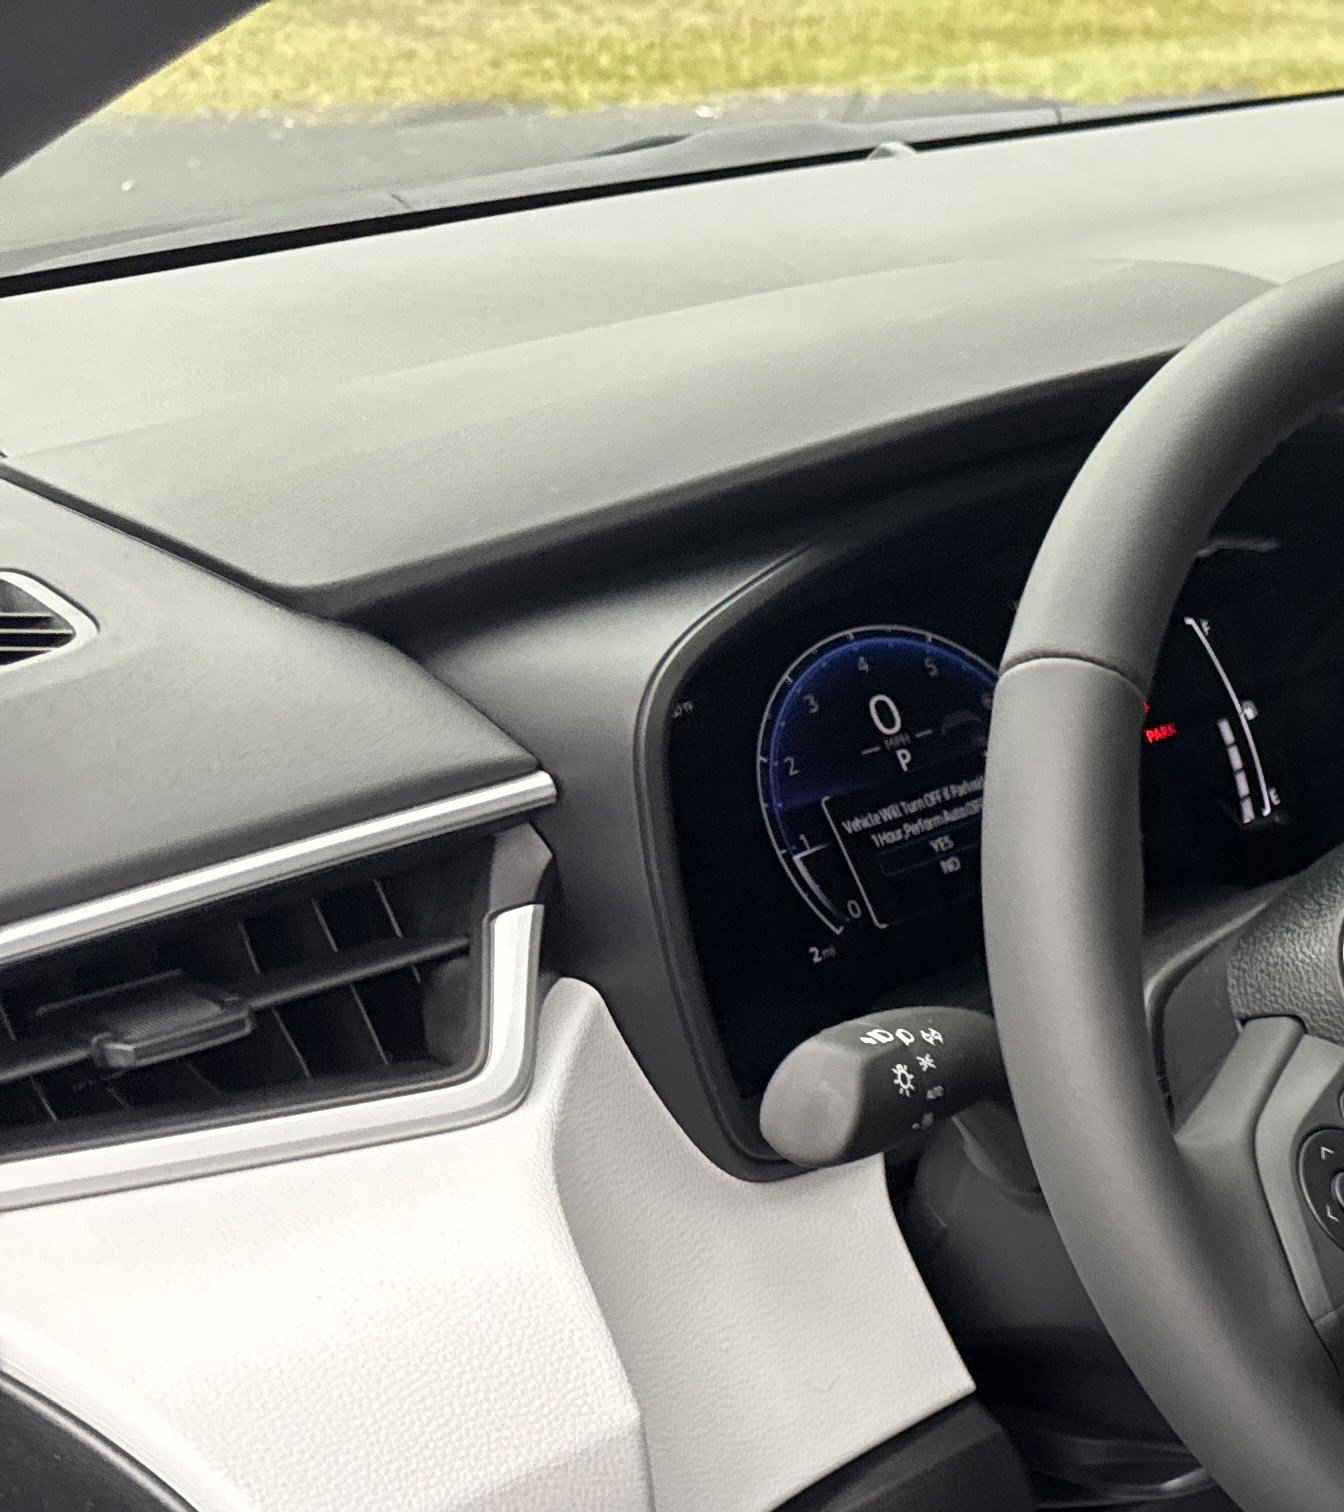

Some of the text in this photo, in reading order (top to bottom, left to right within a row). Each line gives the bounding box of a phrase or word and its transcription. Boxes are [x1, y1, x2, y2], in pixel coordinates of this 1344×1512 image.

[858, 656, 870, 674] 4
[924, 656, 939, 677] 5
[804, 693, 819, 714] 3
[869, 694, 902, 735] 0
[784, 756, 799, 776] 2
[896, 749, 911, 772] P
[1268, 787, 1281, 805] E
[841, 812, 882, 834] Vehicle
[929, 835, 954, 853] YES
[940, 856, 961, 875] NO
[847, 899, 861, 918] 0
